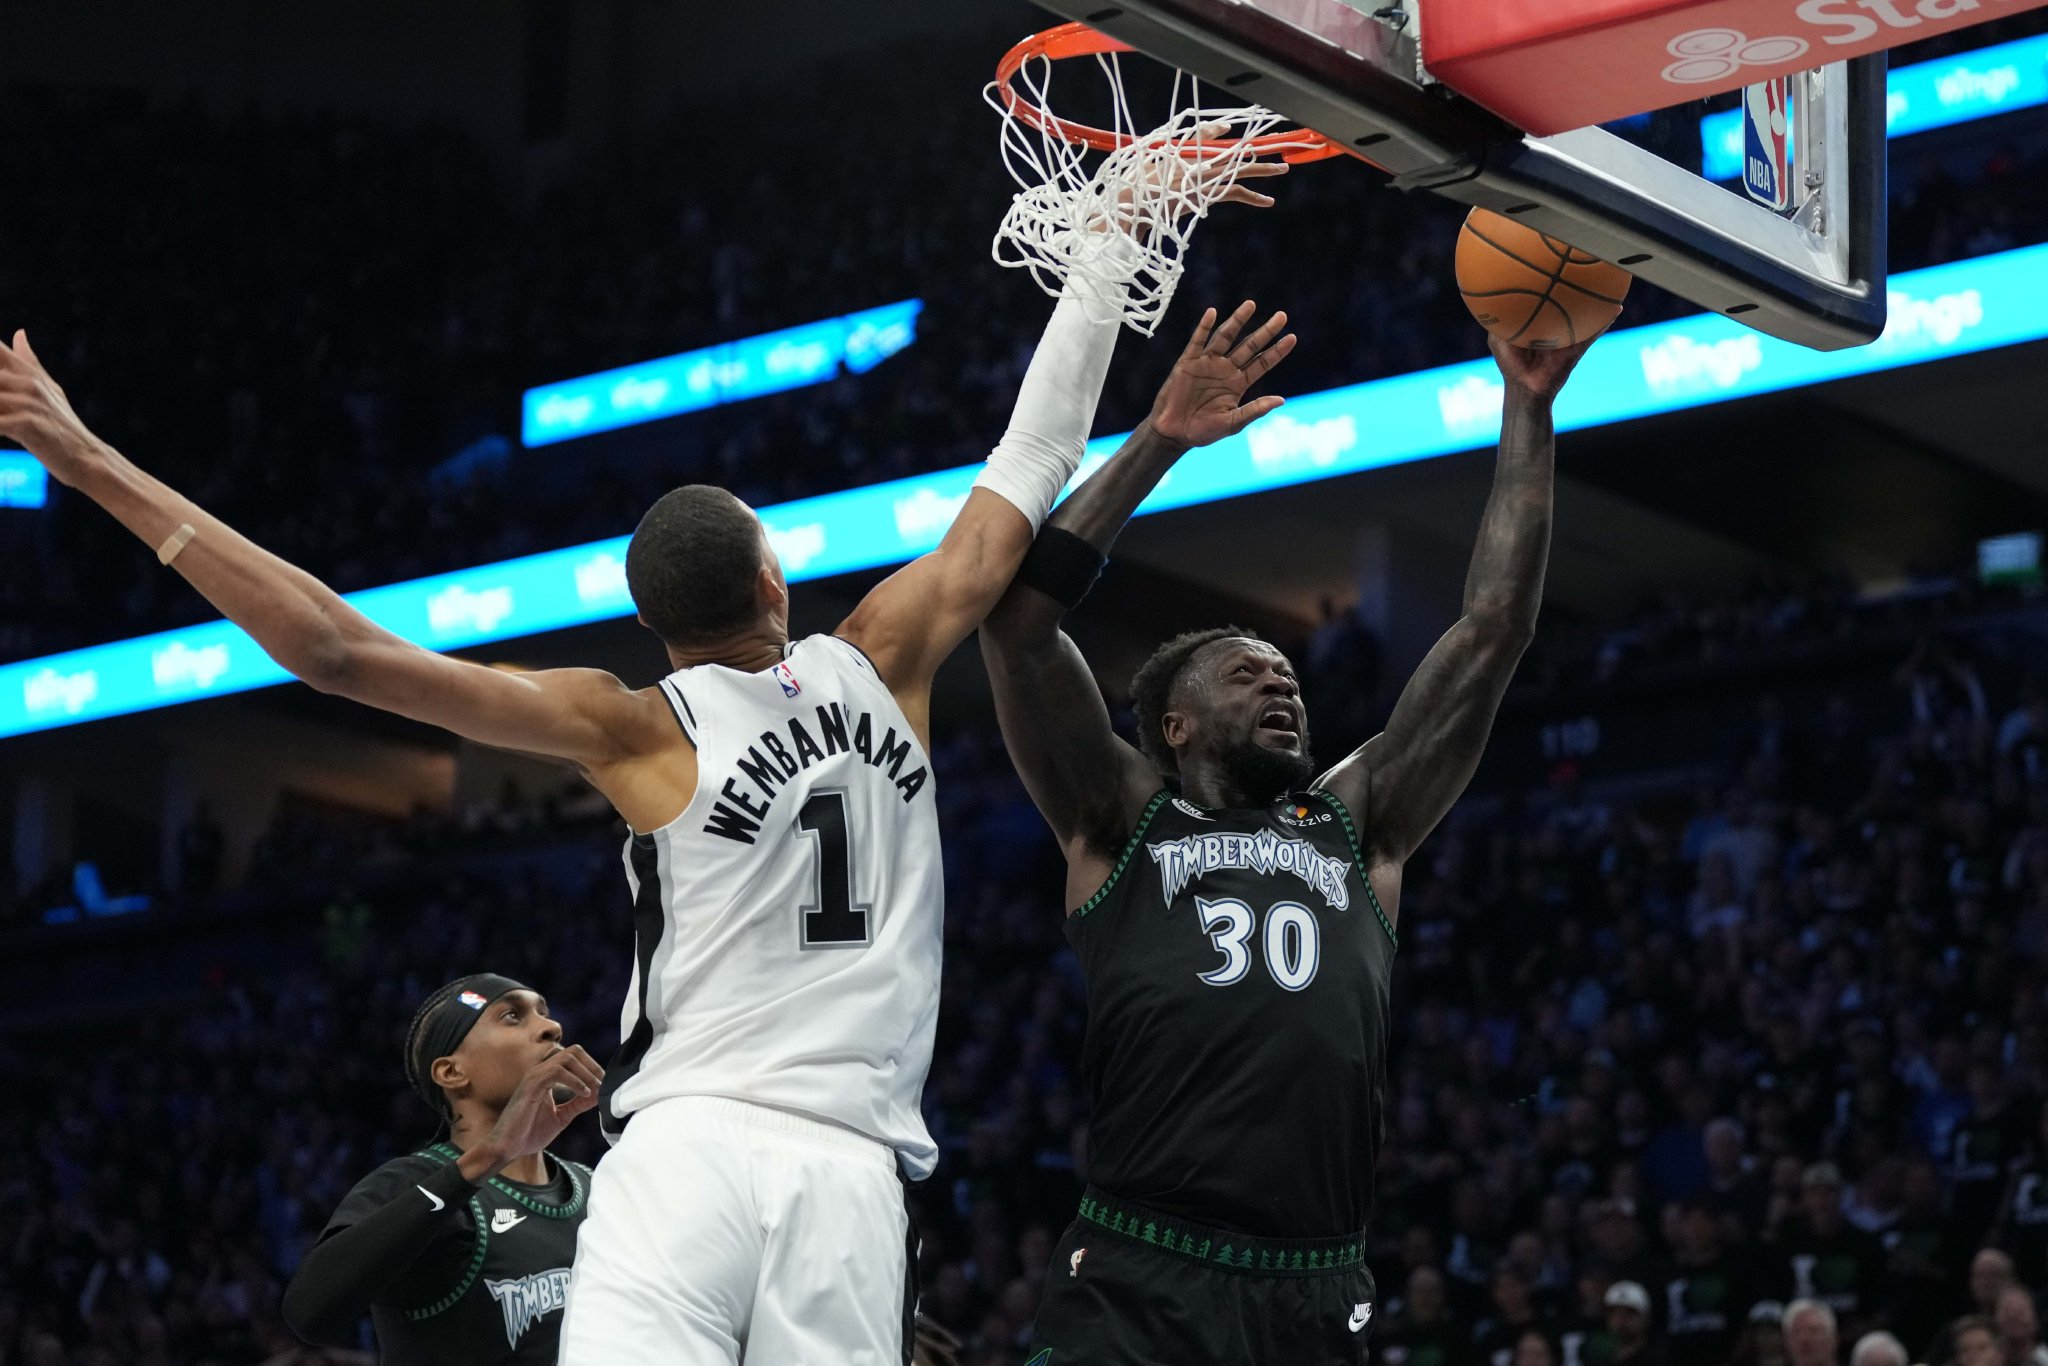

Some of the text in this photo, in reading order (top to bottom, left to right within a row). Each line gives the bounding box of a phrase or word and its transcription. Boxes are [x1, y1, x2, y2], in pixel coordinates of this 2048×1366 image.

[1795, 0, 2006, 45] Sta
[1749, 157, 1771, 193] NBA
[703, 702, 928, 845] WEMBANAMA
[1178, 799, 1205, 817] NIKE
[794, 786, 873, 951] 1
[1146, 827, 1352, 911] TIMBERWOLVES
[1195, 896, 1320, 992] 30
[494, 1208, 517, 1223] NIKE
[1353, 1302, 1373, 1320] NIKE
